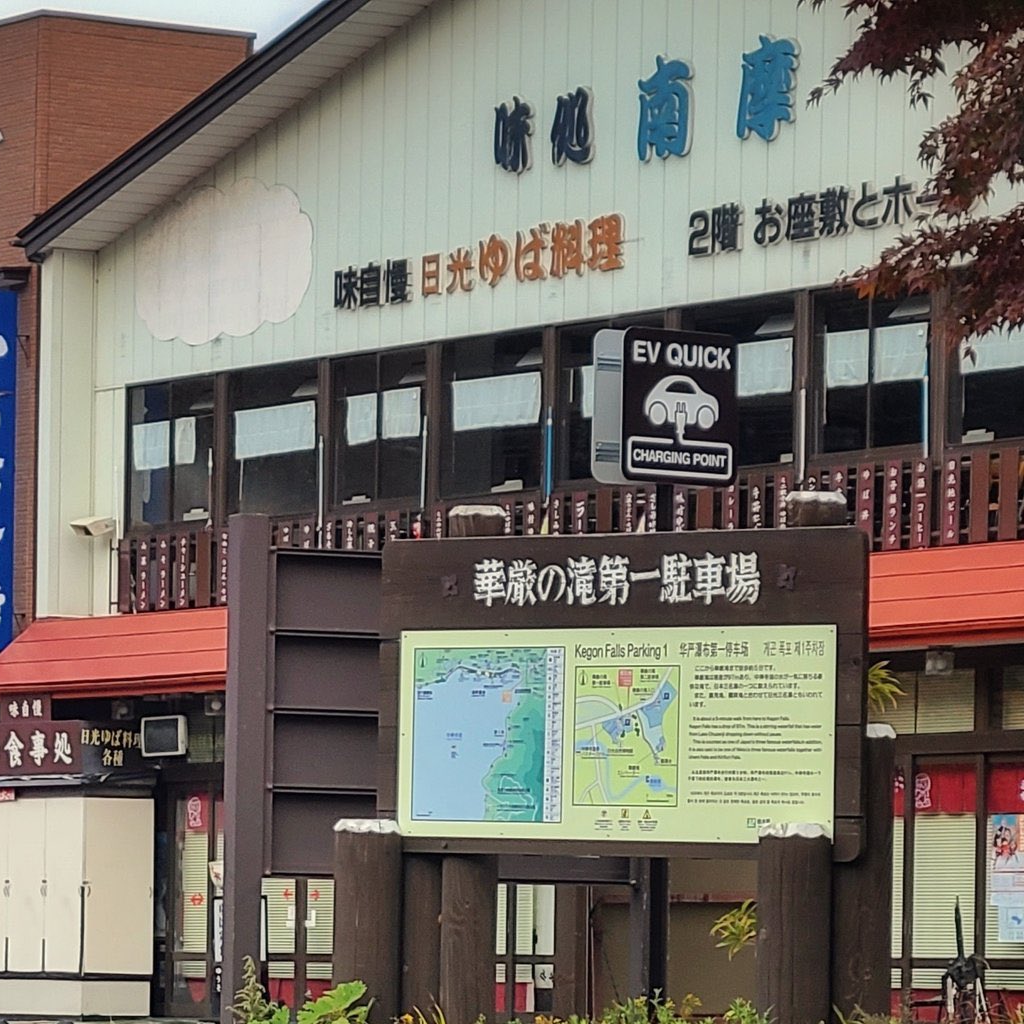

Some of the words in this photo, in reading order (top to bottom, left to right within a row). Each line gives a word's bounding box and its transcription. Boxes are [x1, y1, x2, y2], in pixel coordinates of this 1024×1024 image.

[421, 212, 627, 299] 日光ゆば料理
[632, 340, 661, 364] EV
[666, 343, 732, 370] QUICK
[632, 448, 691, 465] CHARGING
[693, 454, 727, 468] POINT
[473, 551, 761, 607] 華厳の滝第一駐車場
[575, 644, 603, 660] Kegon
[605, 643, 625, 657] Falls
[627, 643, 661, 660] Parking
[663, 643, 668, 657] 1
